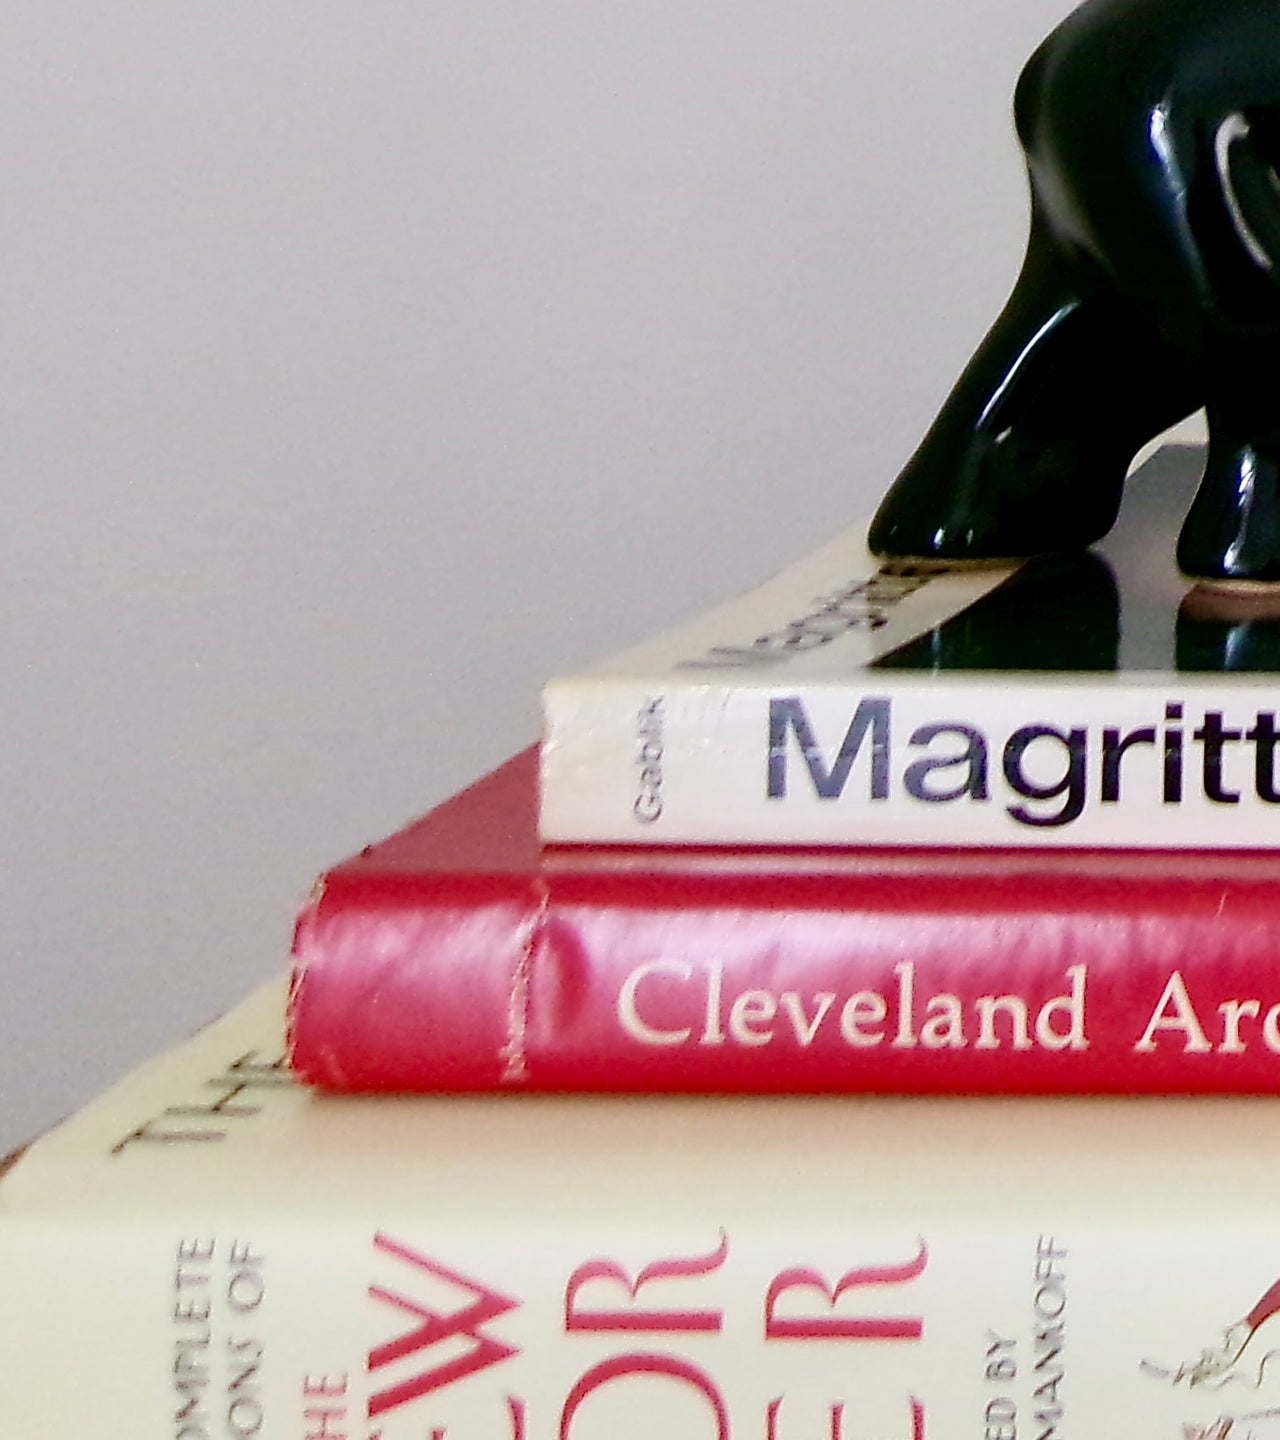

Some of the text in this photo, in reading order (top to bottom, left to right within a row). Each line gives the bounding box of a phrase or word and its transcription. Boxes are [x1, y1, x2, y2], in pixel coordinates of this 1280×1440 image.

[617, 961, 1090, 1052] Cleveland
[226, 1239, 264, 1312] OF
[983, 1327, 1018, 1381] BY
